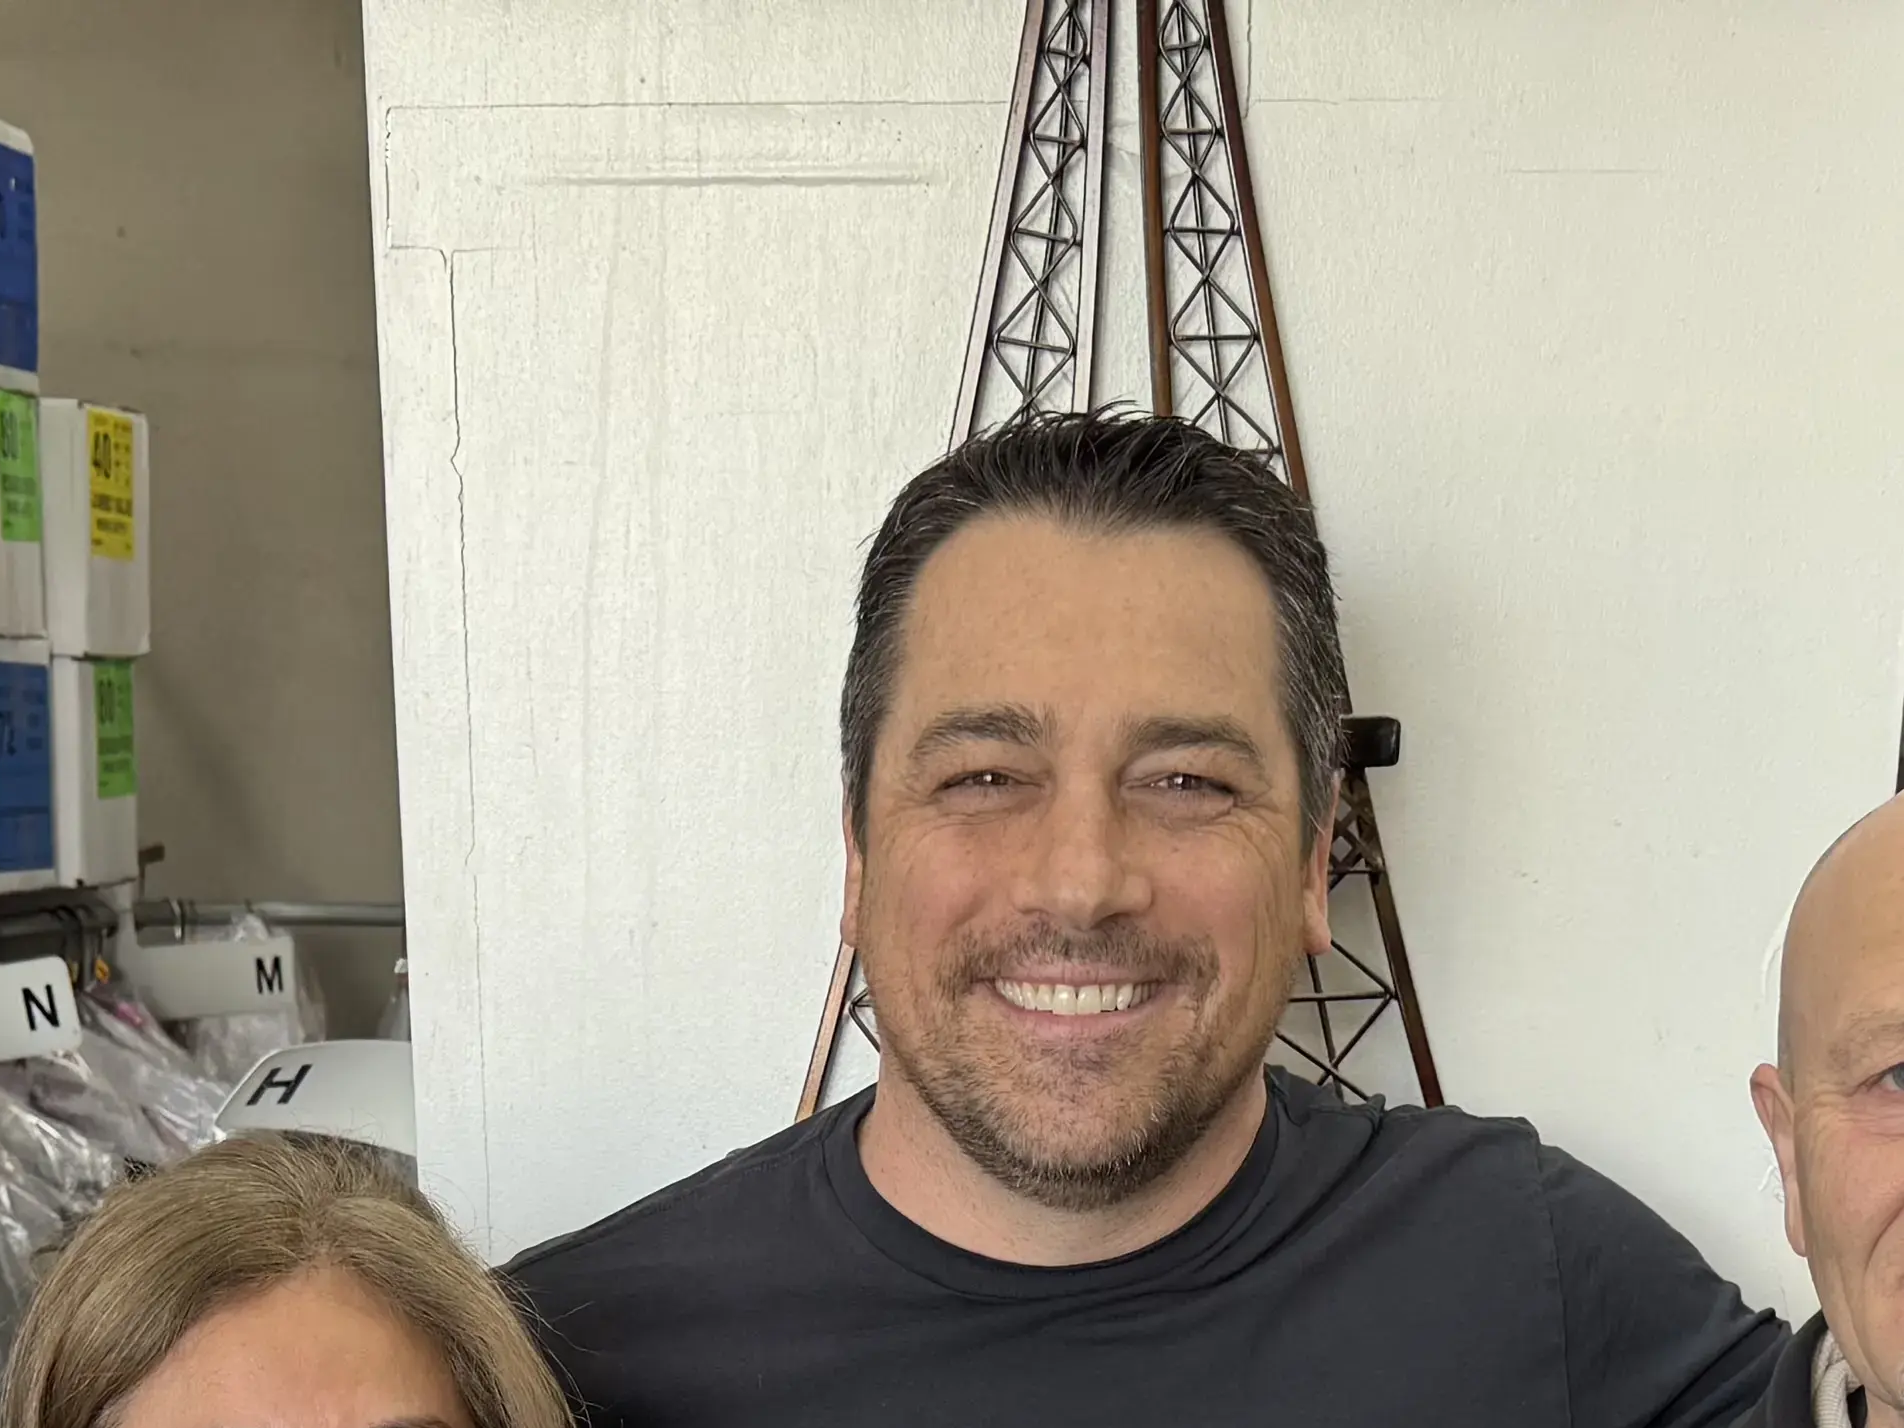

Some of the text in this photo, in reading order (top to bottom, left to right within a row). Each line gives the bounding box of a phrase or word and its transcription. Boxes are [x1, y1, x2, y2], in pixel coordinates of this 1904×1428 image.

[255, 955, 284, 995] M
[21, 984, 61, 1031] N
[246, 1063, 314, 1106] H
